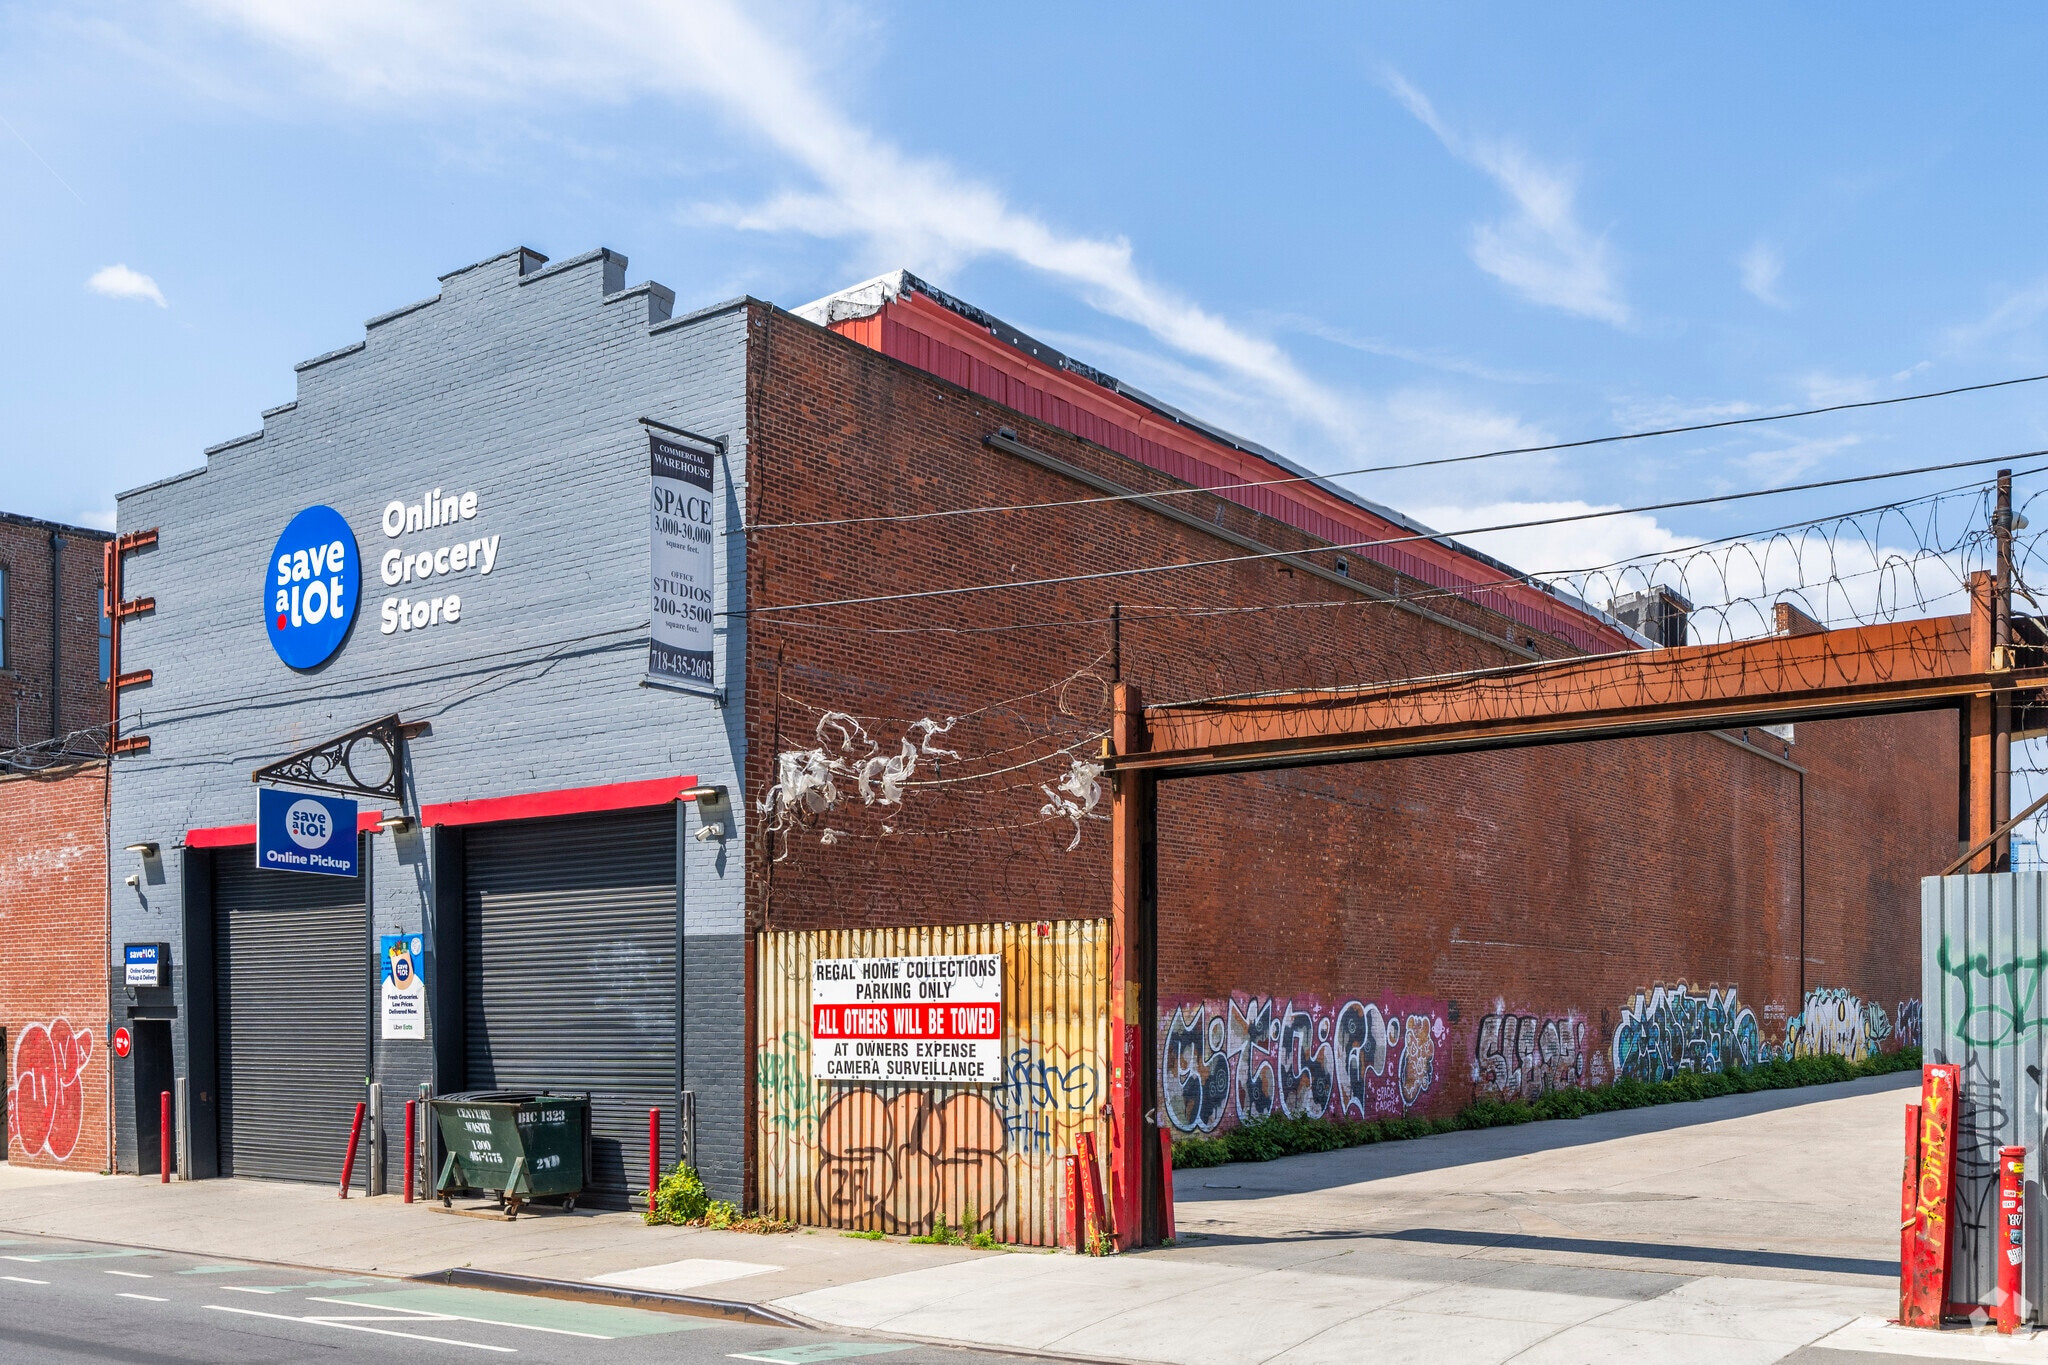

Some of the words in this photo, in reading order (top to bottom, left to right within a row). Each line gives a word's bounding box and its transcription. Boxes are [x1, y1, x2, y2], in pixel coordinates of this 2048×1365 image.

[654, 453, 710, 478] WAREHOUSE
[660, 444, 704, 465] COMMERCIAL
[382, 488, 478, 538] Online
[654, 486, 711, 525] SPACE
[655, 515, 711, 545] 3,000-30,000
[666, 540, 686, 551] square
[687, 544, 699, 554] feet.
[278, 540, 344, 586] save
[381, 535, 501, 585] Grocery
[671, 570, 694, 582] OFFICE
[275, 589, 289, 613] a
[653, 577, 711, 604] STUDIOS
[380, 594, 461, 634] Store
[653, 595, 712, 624] 200-3500
[665, 620, 686, 631] square
[686, 624, 699, 633] feet.
[651, 649, 712, 680] 718-435-2603
[292, 811, 326, 824] save
[266, 850, 308, 865] Online
[310, 854, 351, 871] Pickup
[130, 951, 142, 959] save
[816, 964, 856, 981] REGAL
[862, 962, 899, 979] HOME
[906, 960, 996, 978] COLLECTIONS
[856, 983, 911, 1000] PARKING
[919, 982, 952, 999] ONLY
[817, 1009, 838, 1035] ALL
[844, 1008, 888, 1035] OTHERS
[893, 1008, 922, 1035] WILL
[928, 1007, 945, 1035] BE
[950, 1007, 995, 1035] TOWED
[834, 1043, 849, 1057] AT
[856, 1042, 909, 1057] OWNERS
[916, 1043, 976, 1058] EXPENSE
[827, 1060, 880, 1074] CAMERA
[886, 1061, 985, 1076] SURVEILLANCE
[517, 1111, 538, 1124] BIC
[541, 1109, 566, 1122] 1323
